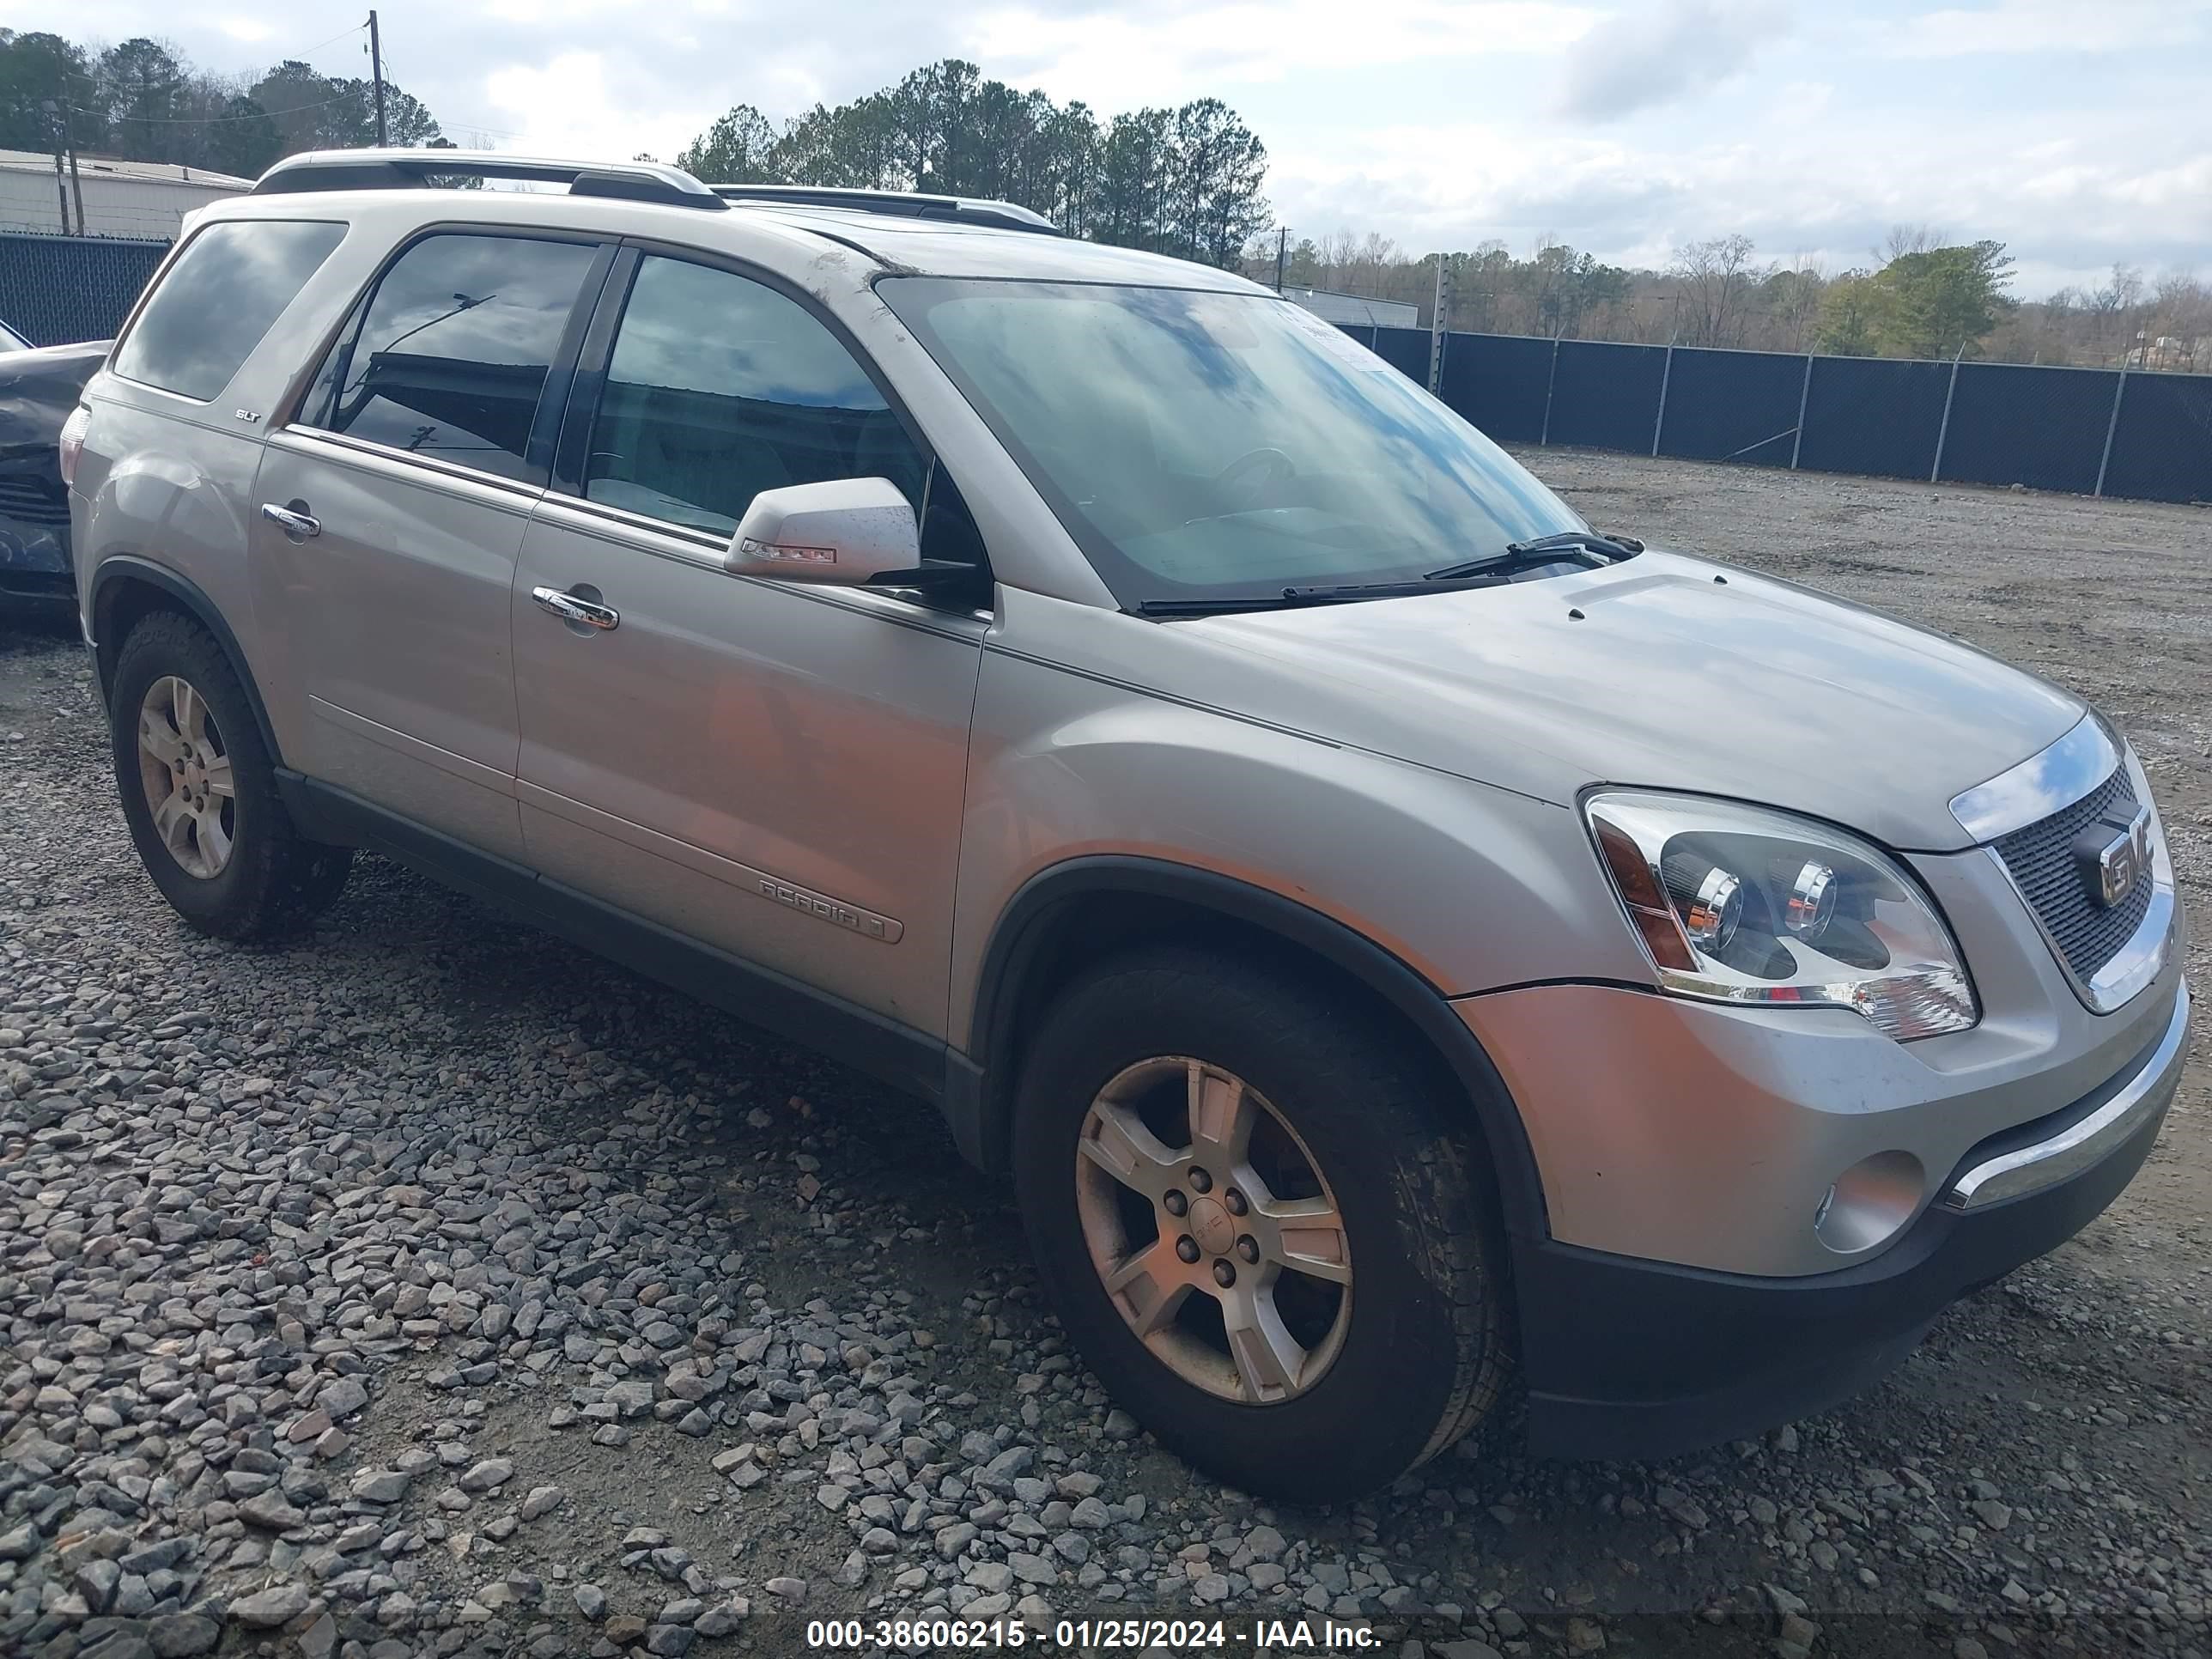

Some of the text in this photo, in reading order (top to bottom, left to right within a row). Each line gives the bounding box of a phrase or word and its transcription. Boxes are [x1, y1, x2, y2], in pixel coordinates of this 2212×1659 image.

[234, 409, 261, 422] SLT
[2100, 805, 2154, 908] GMC
[759, 878, 860, 927] ACADIA
